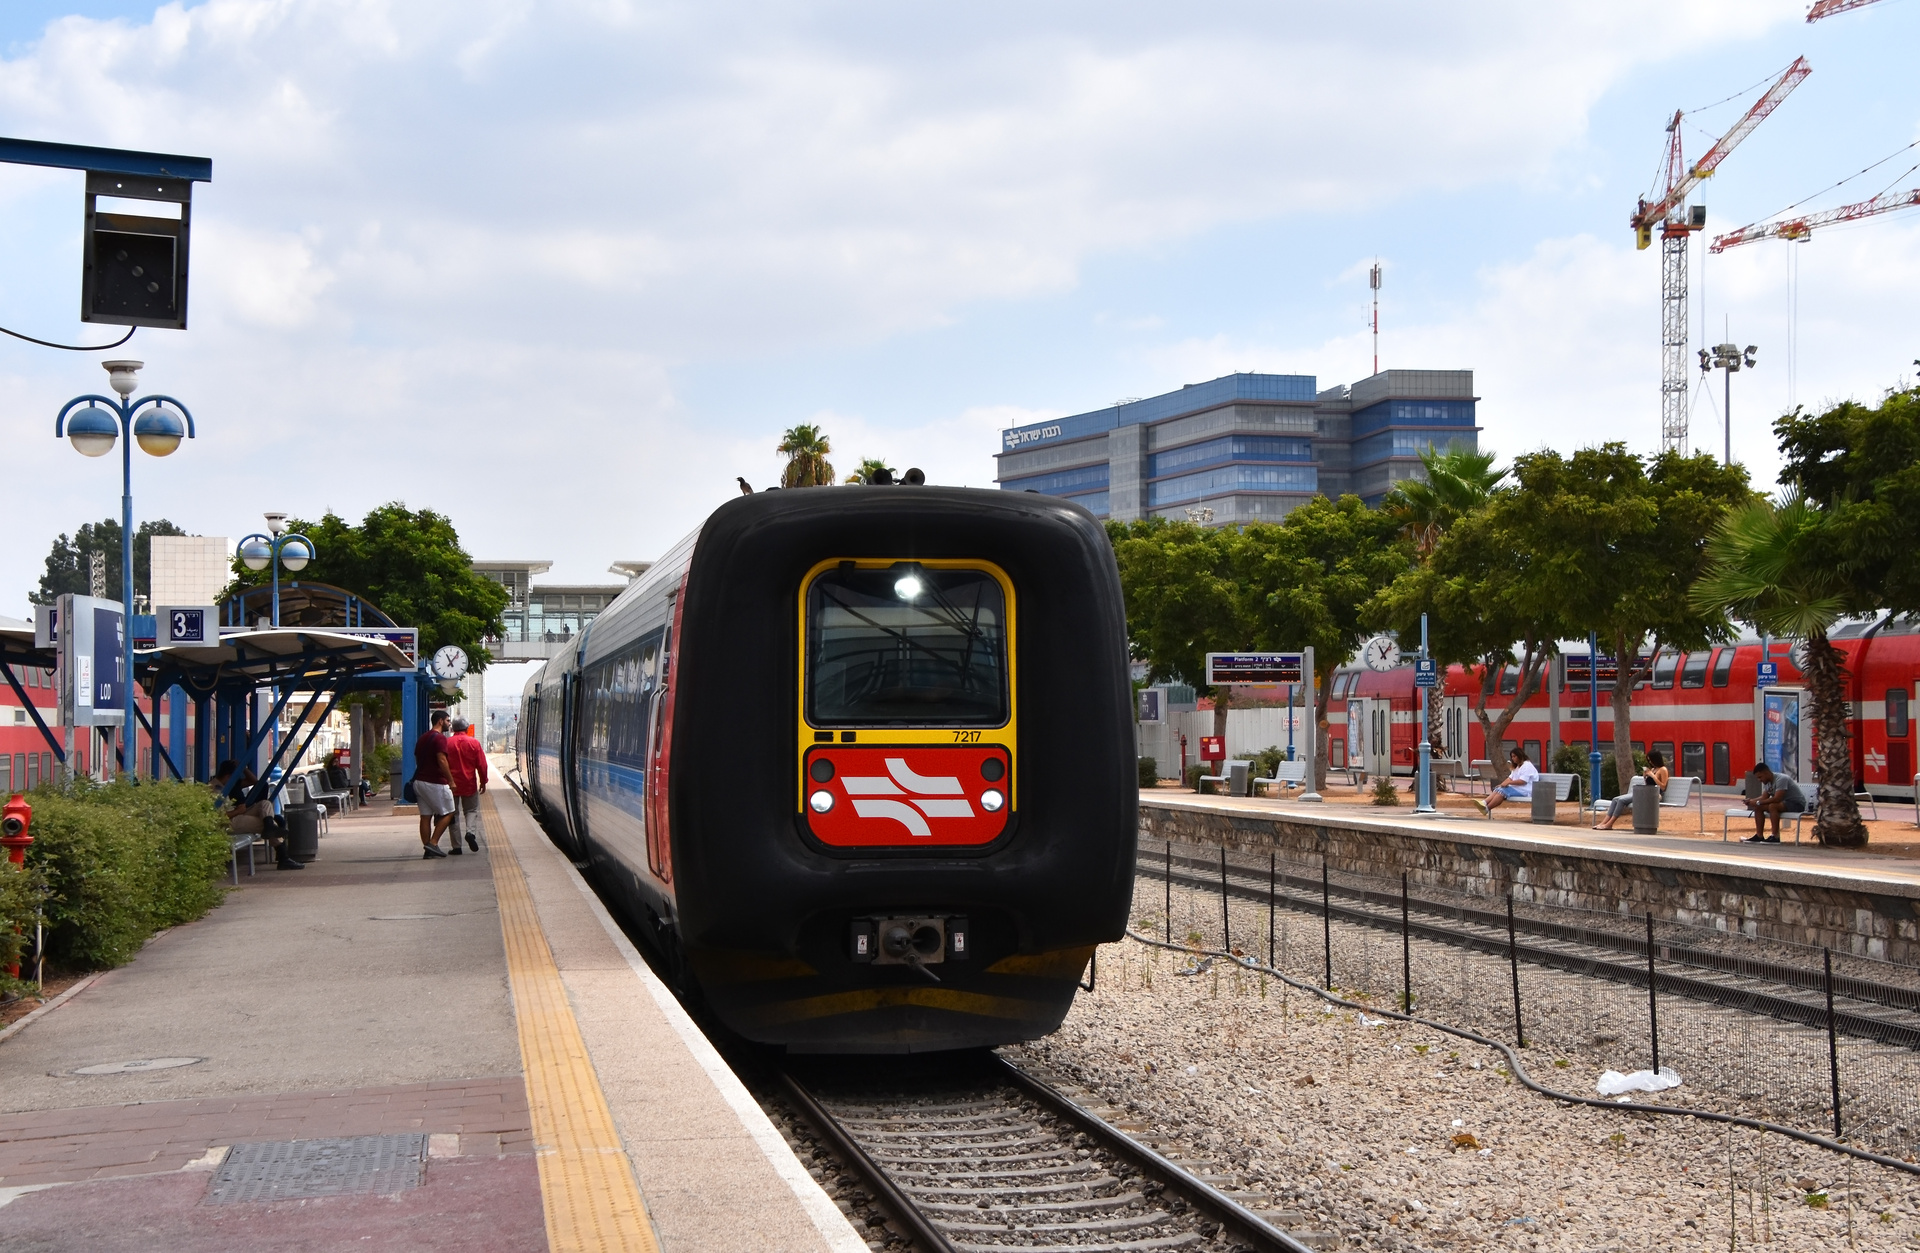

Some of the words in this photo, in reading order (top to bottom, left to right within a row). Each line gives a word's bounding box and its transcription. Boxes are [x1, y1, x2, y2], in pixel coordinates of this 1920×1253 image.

[1018, 429, 1041, 443] ישראל
[1042, 425, 1061, 439] רכבת
[174, 612, 187, 637] 3
[100, 683, 112, 700] LOD
[952, 730, 982, 743] 7217
